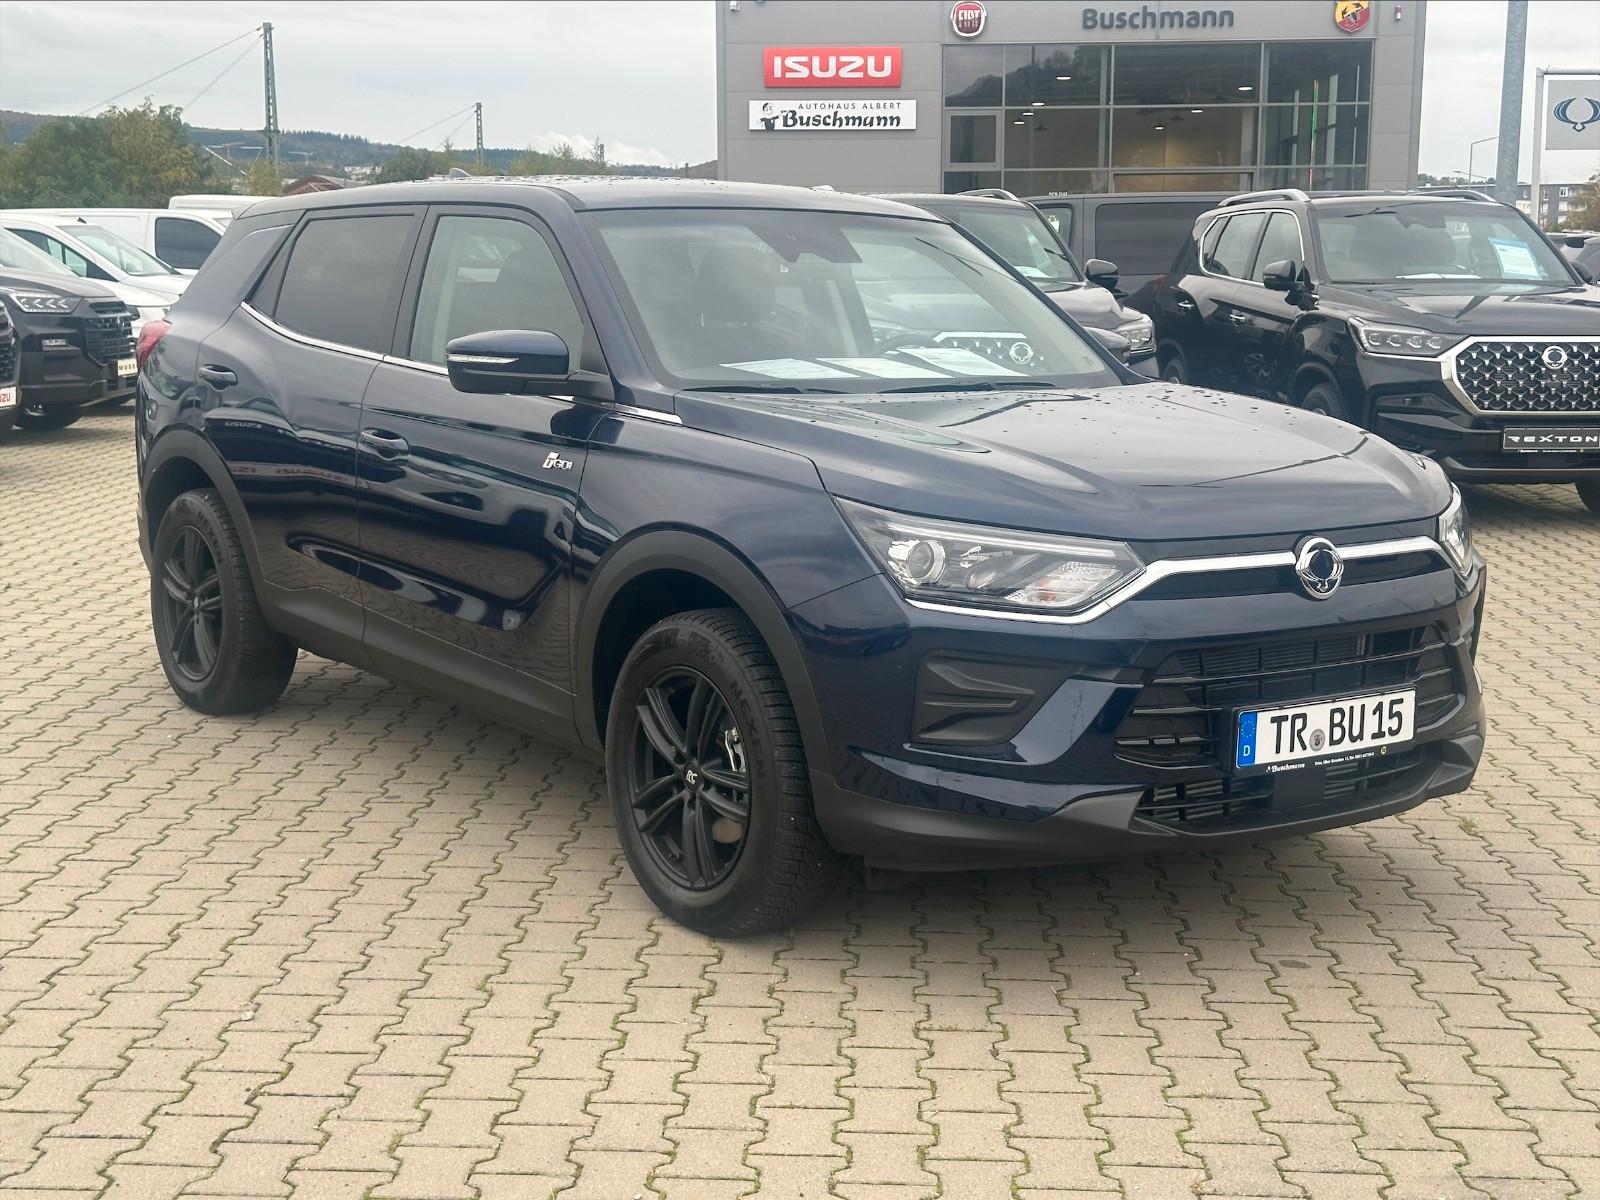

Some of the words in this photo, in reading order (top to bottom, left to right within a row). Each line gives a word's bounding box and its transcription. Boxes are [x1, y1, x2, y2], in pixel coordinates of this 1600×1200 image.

[1082, 6, 1234, 30] Buschmann
[773, 55, 893, 78] ISUZU
[798, 102, 856, 110] AUTOHAUS
[782, 110, 901, 128] Buschmann
[1507, 434, 1598, 443] REXTON
[1270, 712, 1308, 755] TR
[1243, 744, 1251, 757] D
